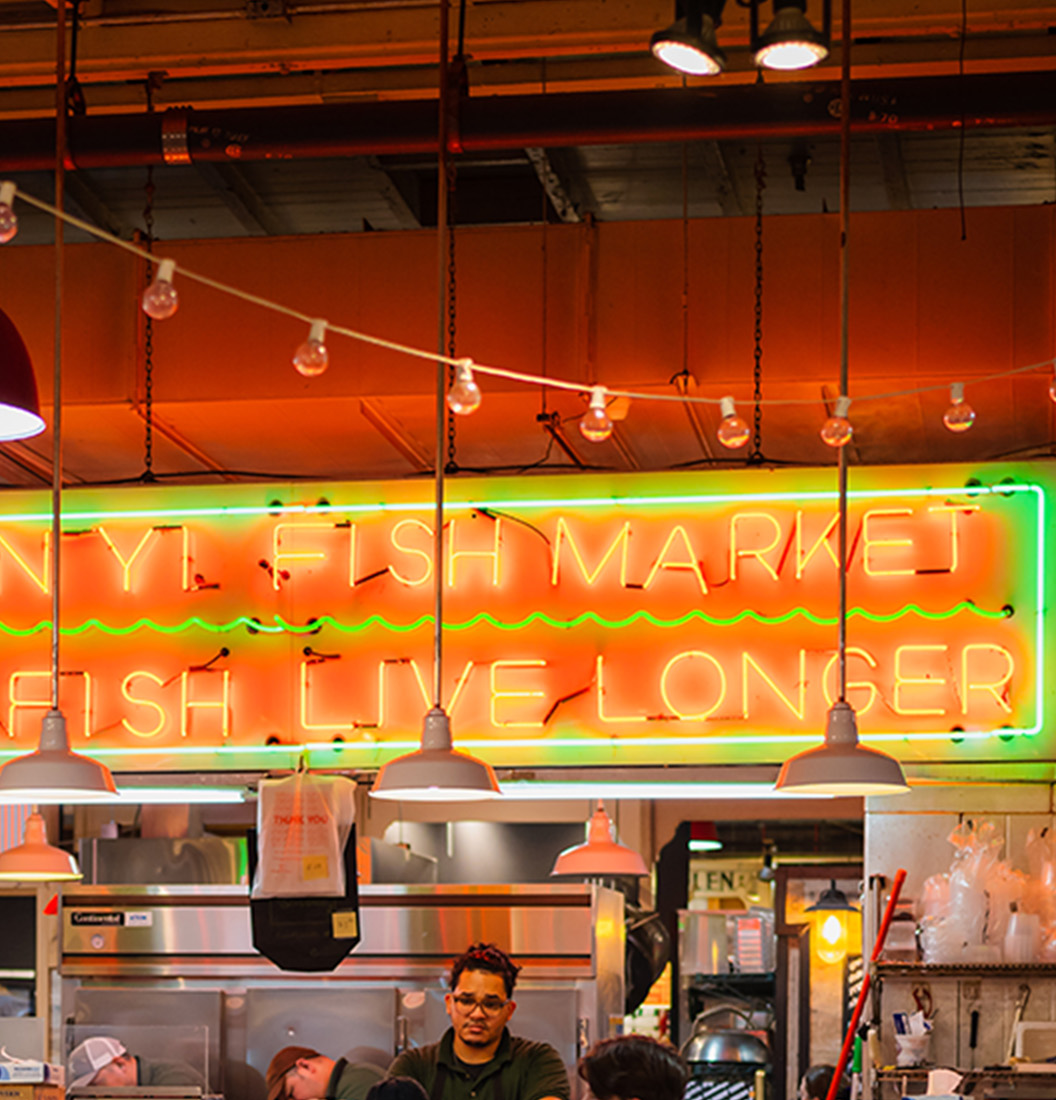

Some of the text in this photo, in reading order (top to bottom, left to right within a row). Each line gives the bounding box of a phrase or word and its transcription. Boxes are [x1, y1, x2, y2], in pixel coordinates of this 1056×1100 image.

[98, 525, 189, 592] YI
[272, 517, 502, 590] FISH
[550, 504, 982, 595] MARKET
[6, 670, 231, 737] FISH
[300, 657, 548, 730] LIVE
[595, 642, 1015, 722] LONGER
[307, 813, 329, 825] YOU
[73, 912, 121, 924] Continental
